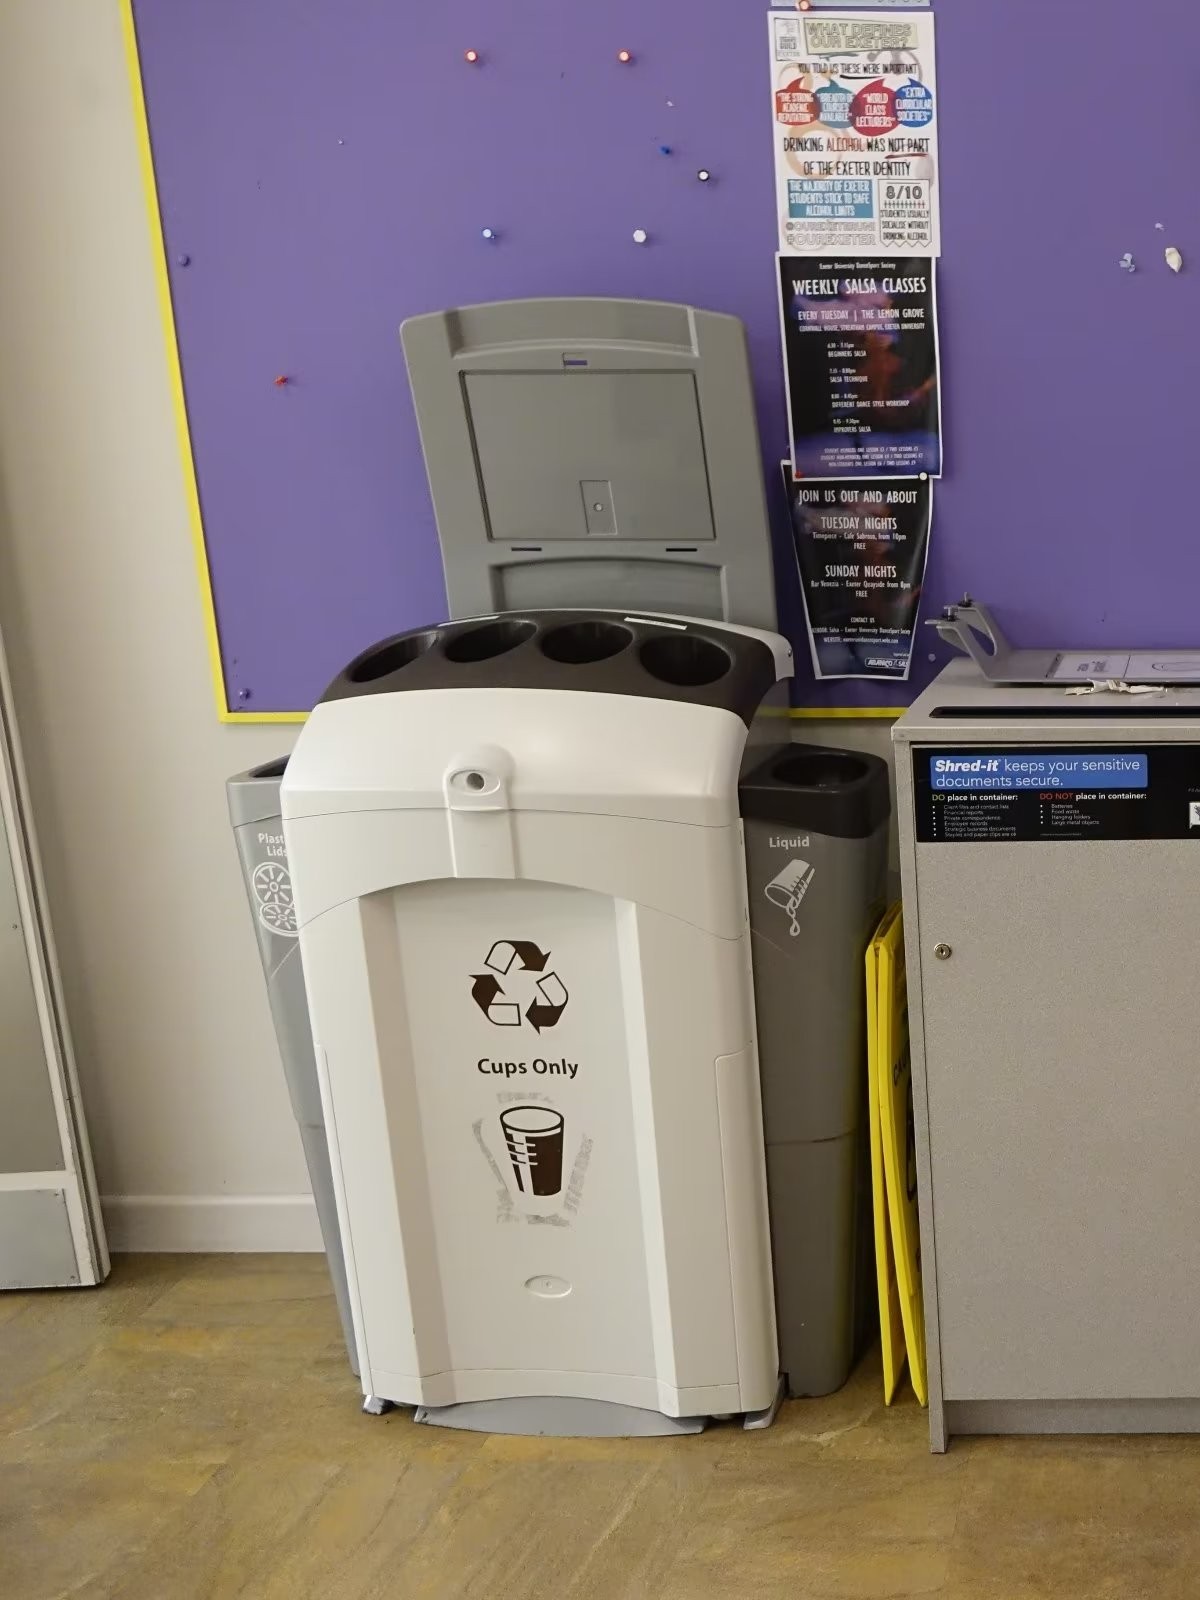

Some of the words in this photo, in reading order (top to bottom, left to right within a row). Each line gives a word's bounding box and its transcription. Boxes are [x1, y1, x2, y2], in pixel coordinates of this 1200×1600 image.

[806, 23, 848, 36] WHAT
[851, 23, 911, 38] DEFINES
[811, 36, 841, 48] OUR
[845, 36, 908, 49] EXETER?
[840, 63, 861, 74] THESE
[863, 64, 880, 74] WERE
[883, 64, 919, 74] IMPORTANT
[864, 104, 887, 115] CLASS
[783, 138, 823, 152] DRINKING
[827, 138, 864, 151] ALCOHOL
[866, 138, 886, 151] WAS
[888, 138, 907, 151] NOT
[907, 137, 930, 151] PART
[803, 162, 814, 175] OF
[817, 161, 833, 175] THE
[836, 161, 870, 175] EXETER
[873, 161, 911, 175] IDENTITY
[844, 180, 870, 191] EXETER
[886, 185, 922, 199] 8/10
[790, 192, 823, 204] STUDENTS
[853, 192, 870, 204] SAFE
[792, 279, 839, 295] WEEKLY
[845, 278, 878, 294] SALSA
[882, 277, 927, 293] CLASSES
[798, 310, 818, 320] EVERY
[820, 310, 849, 320] TUESDAY
[861, 309, 875, 319] THE
[877, 309, 900, 319] LEMON
[902, 308, 925, 318] GROVE
[798, 490, 819, 504] JOIN
[824, 490, 836, 502] US
[840, 490, 859, 503] OUT
[863, 490, 883, 503] AND
[886, 491, 917, 504] ABOUT
[821, 516, 860, 529] TUESDAY
[864, 517, 897, 530] NIGHTS
[825, 565, 860, 577] SUNDAY
[864, 565, 897, 578] NIGHTS
[863, 581, 885, 589] Quayside
[934, 759, 998, 772] Shred-it
[1004, 758, 1045, 774] keeps
[1048, 761, 1079, 777] your
[1082, 758, 1140, 771] sensitive
[936, 774, 1012, 787] documents
[1016, 774, 1063, 786] secure.
[947, 794, 968, 802] place
[1075, 793, 1096, 801] place
[258, 832, 285, 845] Plast
[769, 836, 810, 850] Liquid
[476, 1058, 527, 1077] Cups
[532, 1058, 579, 1079] Only
